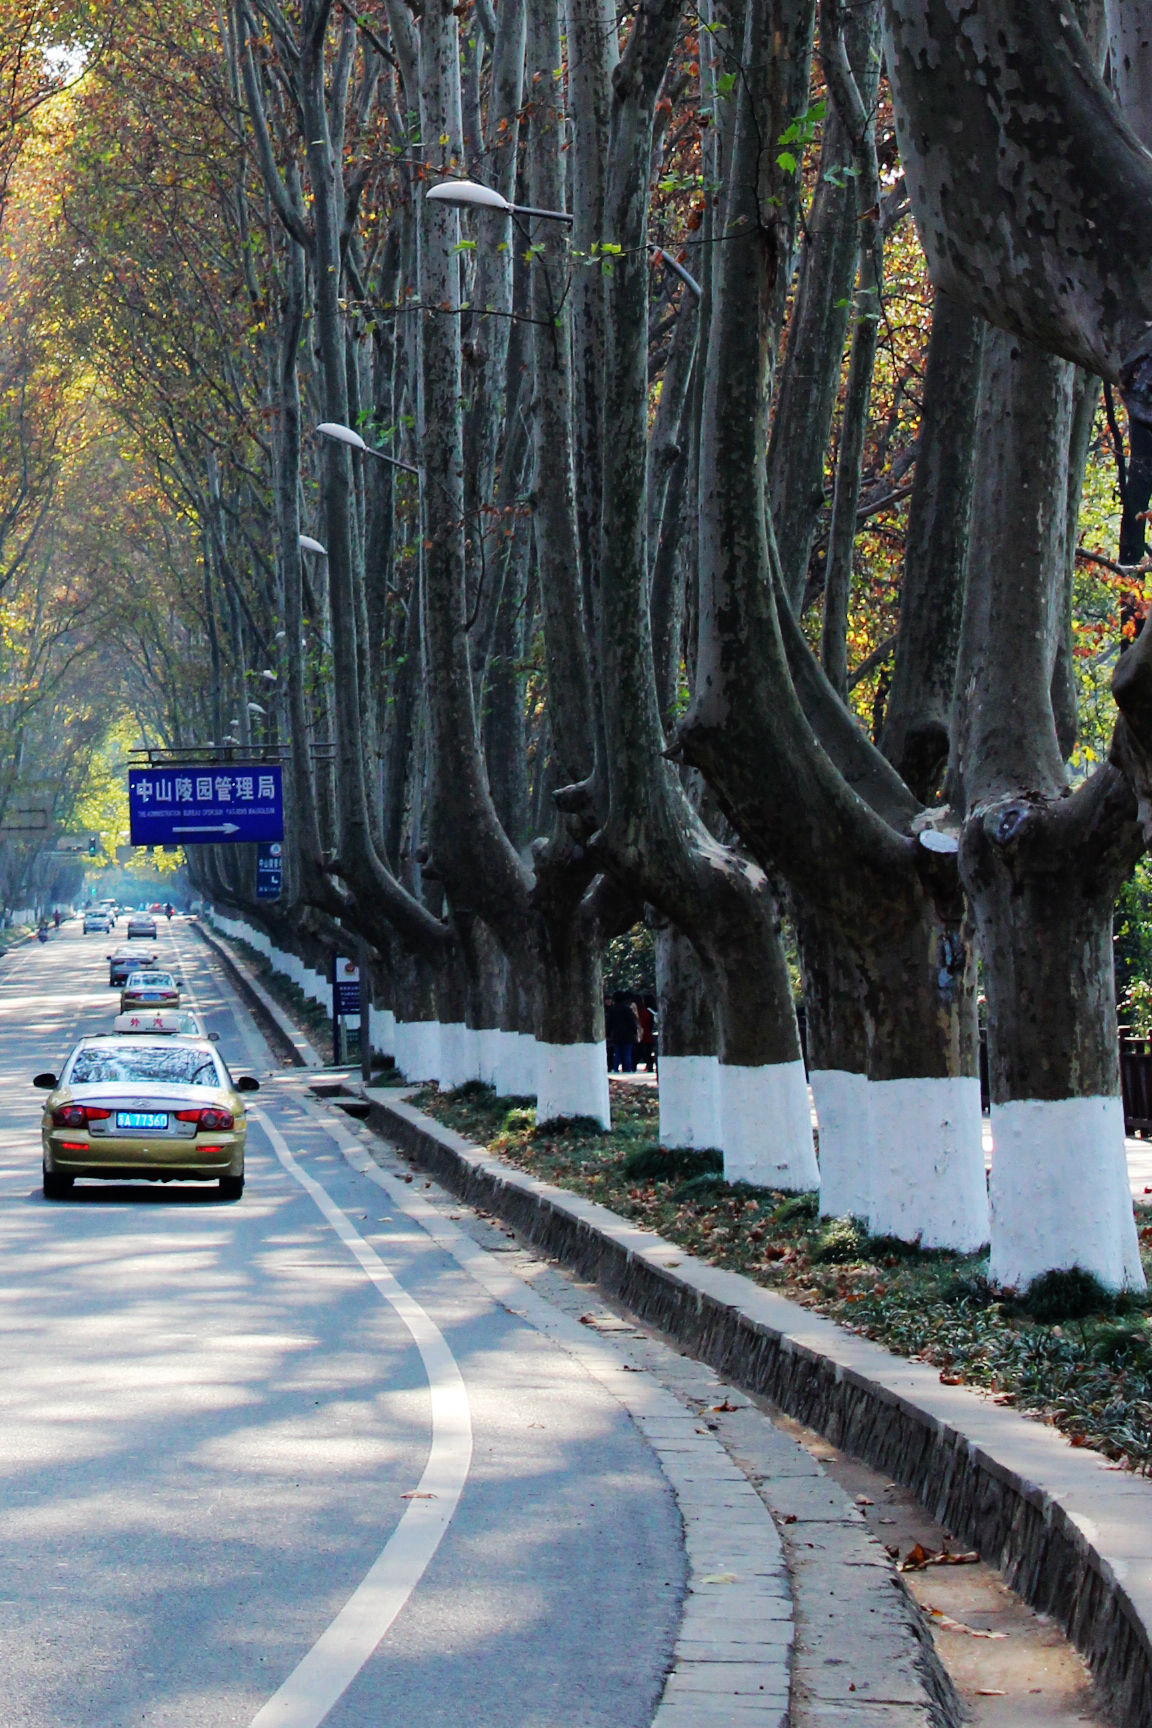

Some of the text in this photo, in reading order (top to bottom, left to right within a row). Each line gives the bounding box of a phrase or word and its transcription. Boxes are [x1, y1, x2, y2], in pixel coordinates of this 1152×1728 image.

[136, 775, 275, 803] 中山陵园管理局
